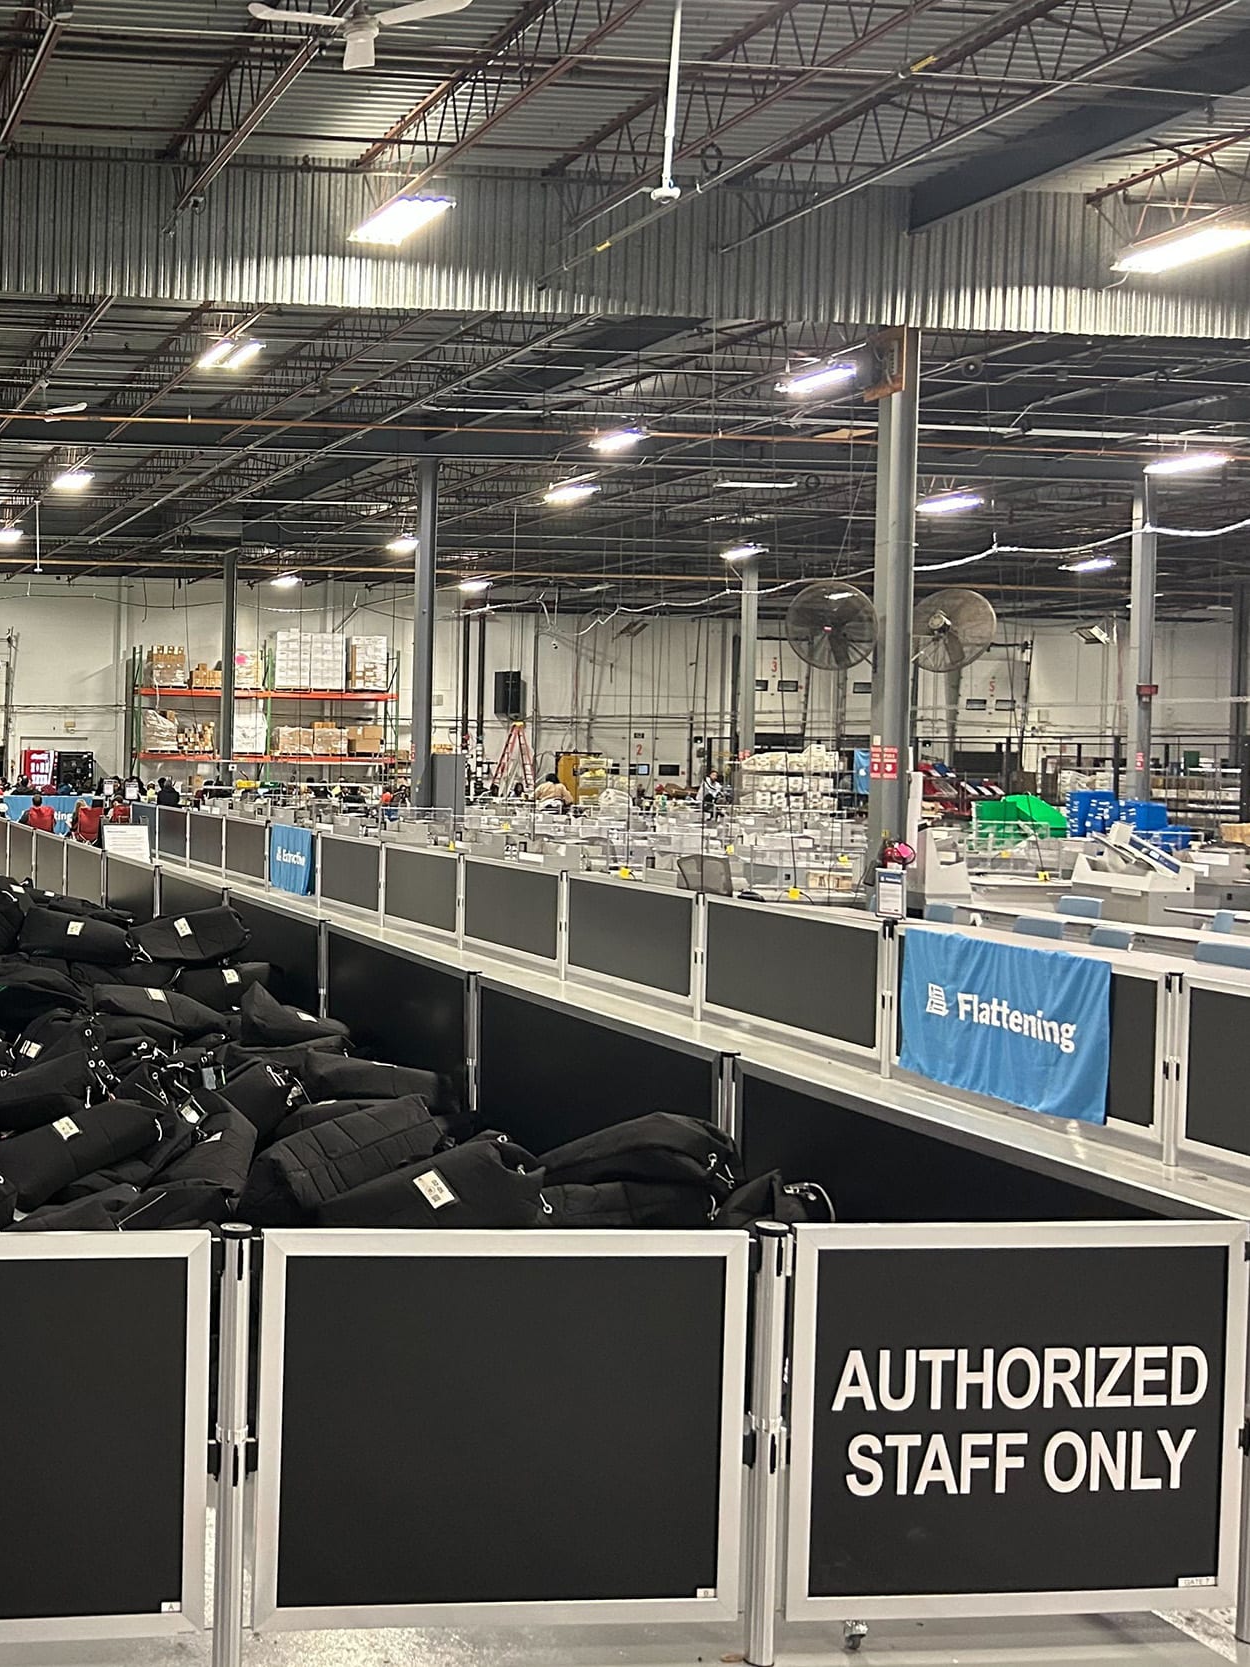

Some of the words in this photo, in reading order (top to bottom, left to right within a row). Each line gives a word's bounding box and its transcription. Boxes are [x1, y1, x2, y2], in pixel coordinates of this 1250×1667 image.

[771, 661, 777, 672] 3
[989, 680, 996, 692] 5
[636, 743, 643, 756] 2
[957, 992, 1077, 1054] Flattening
[831, 1346, 1209, 1412] AUTHORIZED
[845, 1432, 1029, 1497] STAFF
[1044, 1428, 1197, 1494] ONLY
